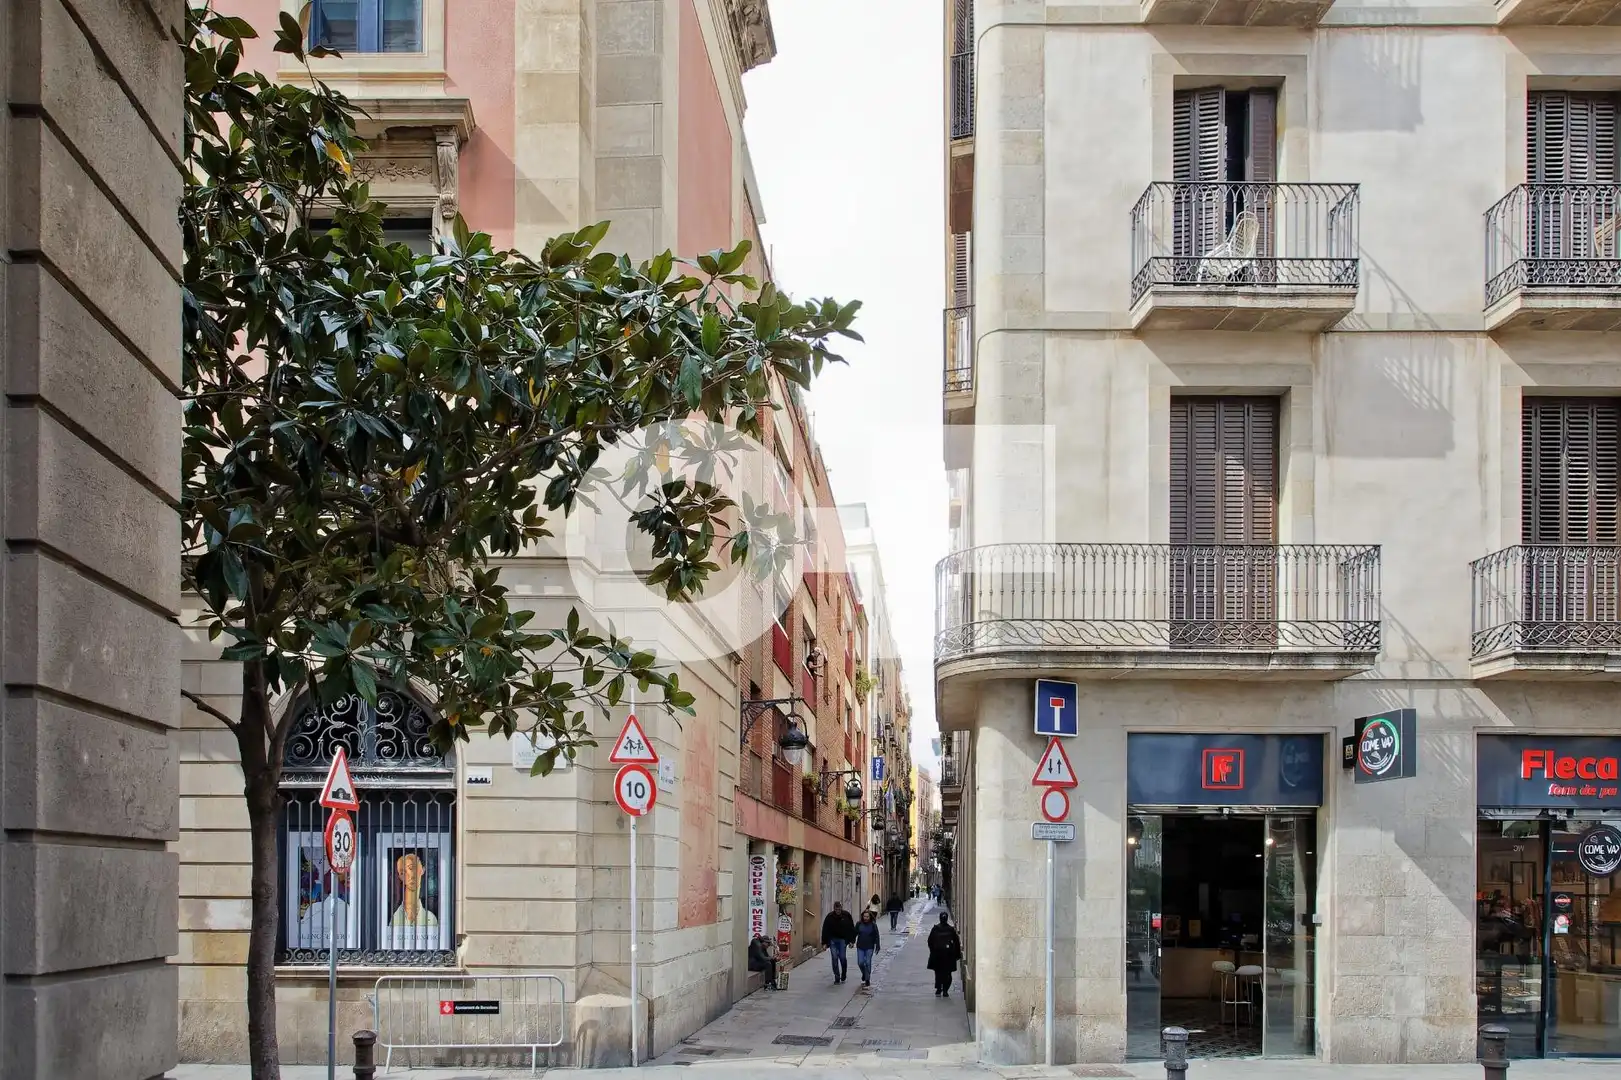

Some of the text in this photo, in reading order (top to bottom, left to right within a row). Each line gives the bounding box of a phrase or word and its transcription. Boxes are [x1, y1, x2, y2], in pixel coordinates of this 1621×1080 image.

[1362, 739, 1379, 751] COME
[1212, 755, 1234, 783] F
[1521, 749, 1618, 779] Fleca
[626, 781, 645, 799] 10
[1599, 787, 1618, 798] pa
[334, 831, 351, 853] 30
[1584, 844, 1605, 855] COME
[752, 865, 763, 897] SUPER
